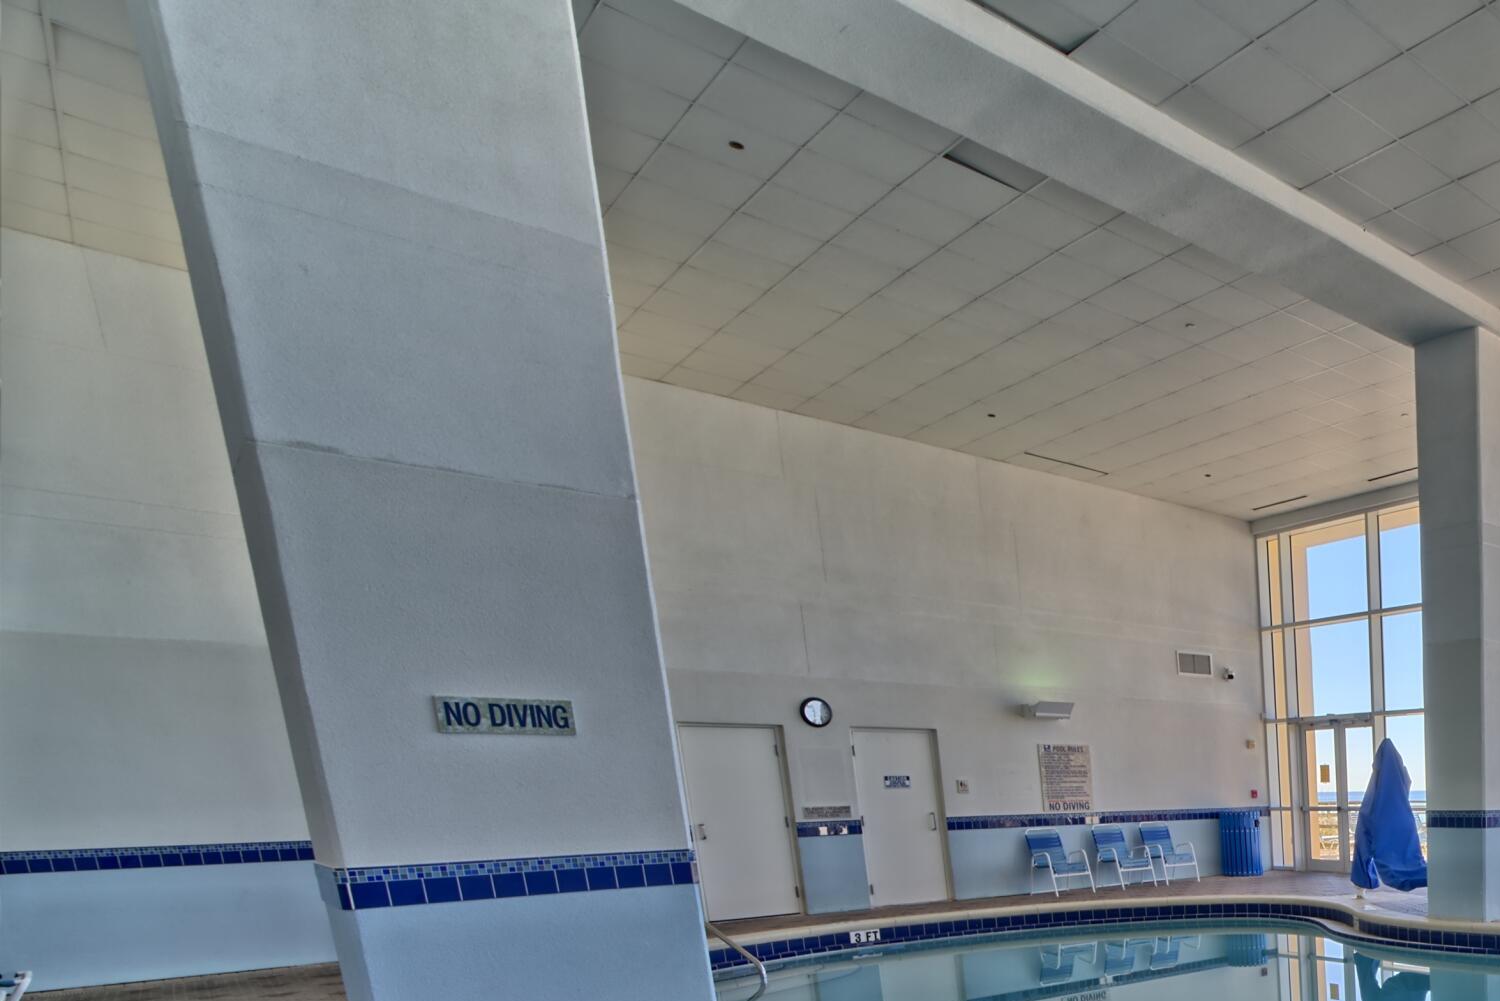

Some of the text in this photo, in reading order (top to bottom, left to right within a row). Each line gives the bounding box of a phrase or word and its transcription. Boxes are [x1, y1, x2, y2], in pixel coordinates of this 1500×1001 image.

[443, 702, 570, 729] NO DIVING
[1049, 802, 1061, 811] NO
[1062, 801, 1090, 811] DIVING
[855, 931, 878, 943] 3 FT
